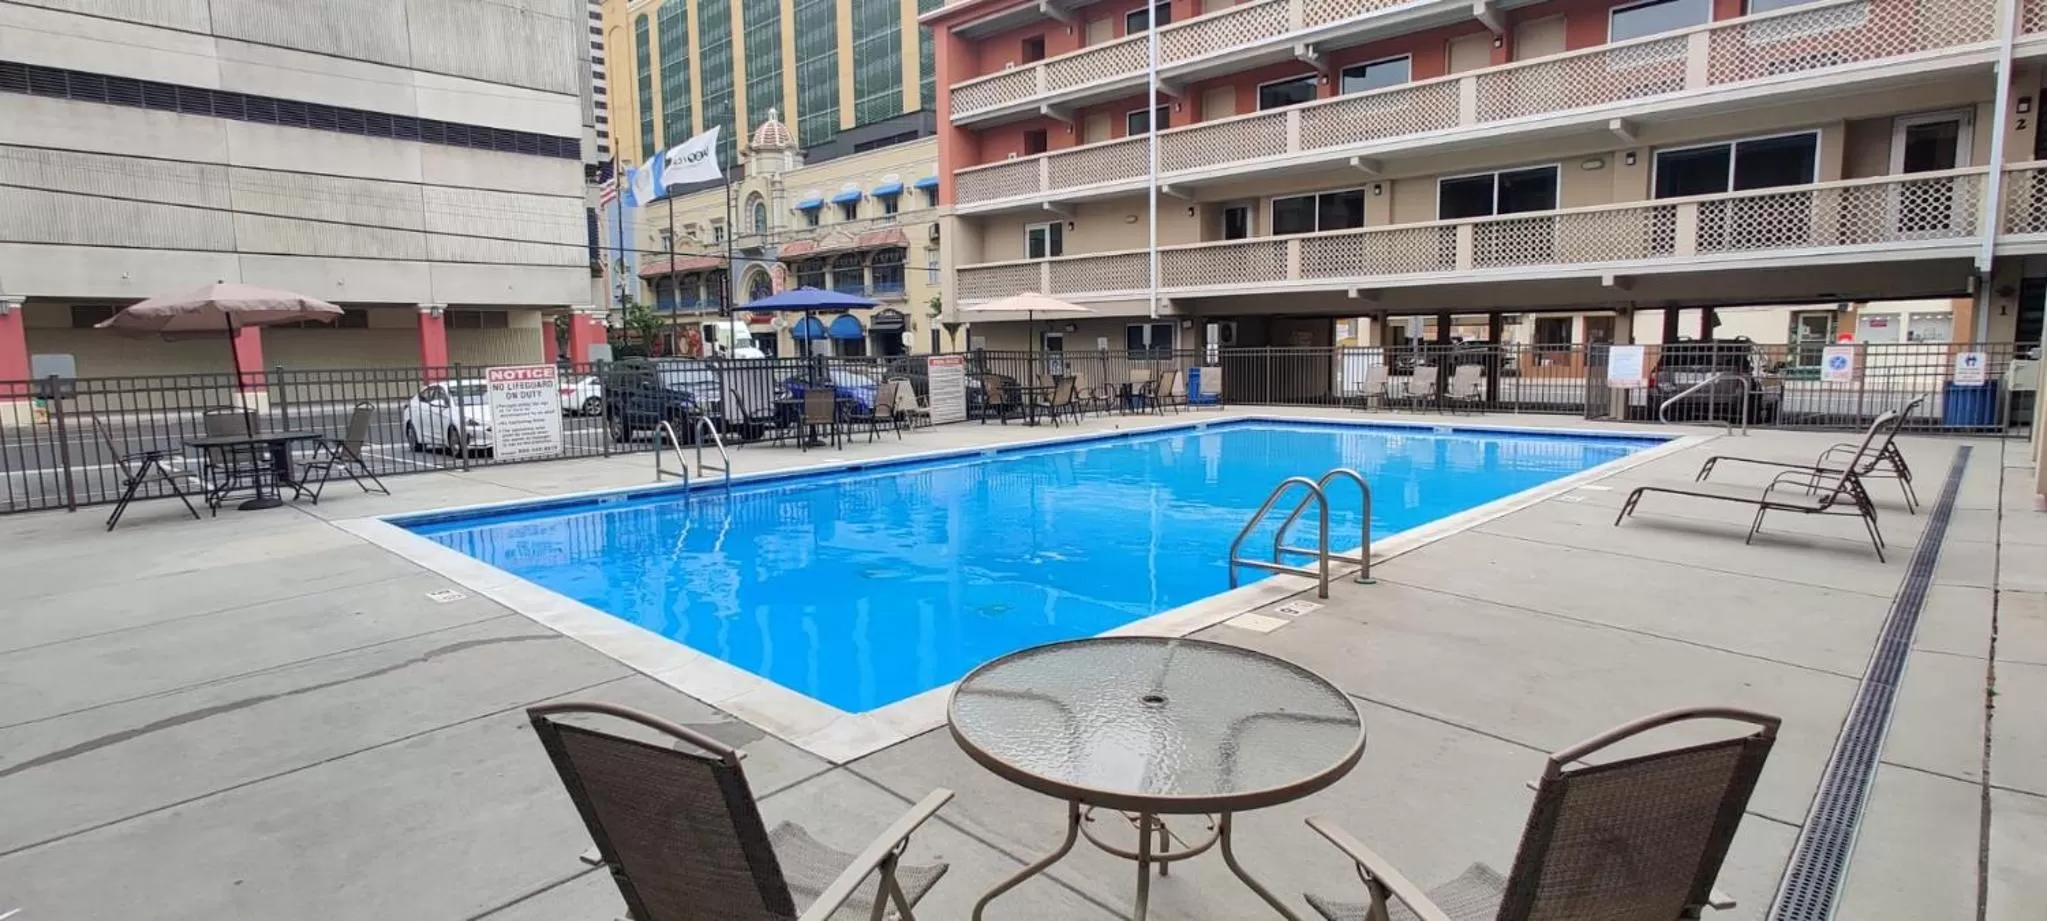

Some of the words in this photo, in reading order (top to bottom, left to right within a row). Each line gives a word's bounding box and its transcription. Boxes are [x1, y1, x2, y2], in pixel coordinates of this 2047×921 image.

[2016, 119, 2026, 130] 2
[491, 368, 552, 380] NOTICE
[493, 383, 504, 391] NO
[507, 381, 553, 390] LIFEGUARD
[506, 391, 518, 400] ON
[520, 390, 542, 399] DUTY
